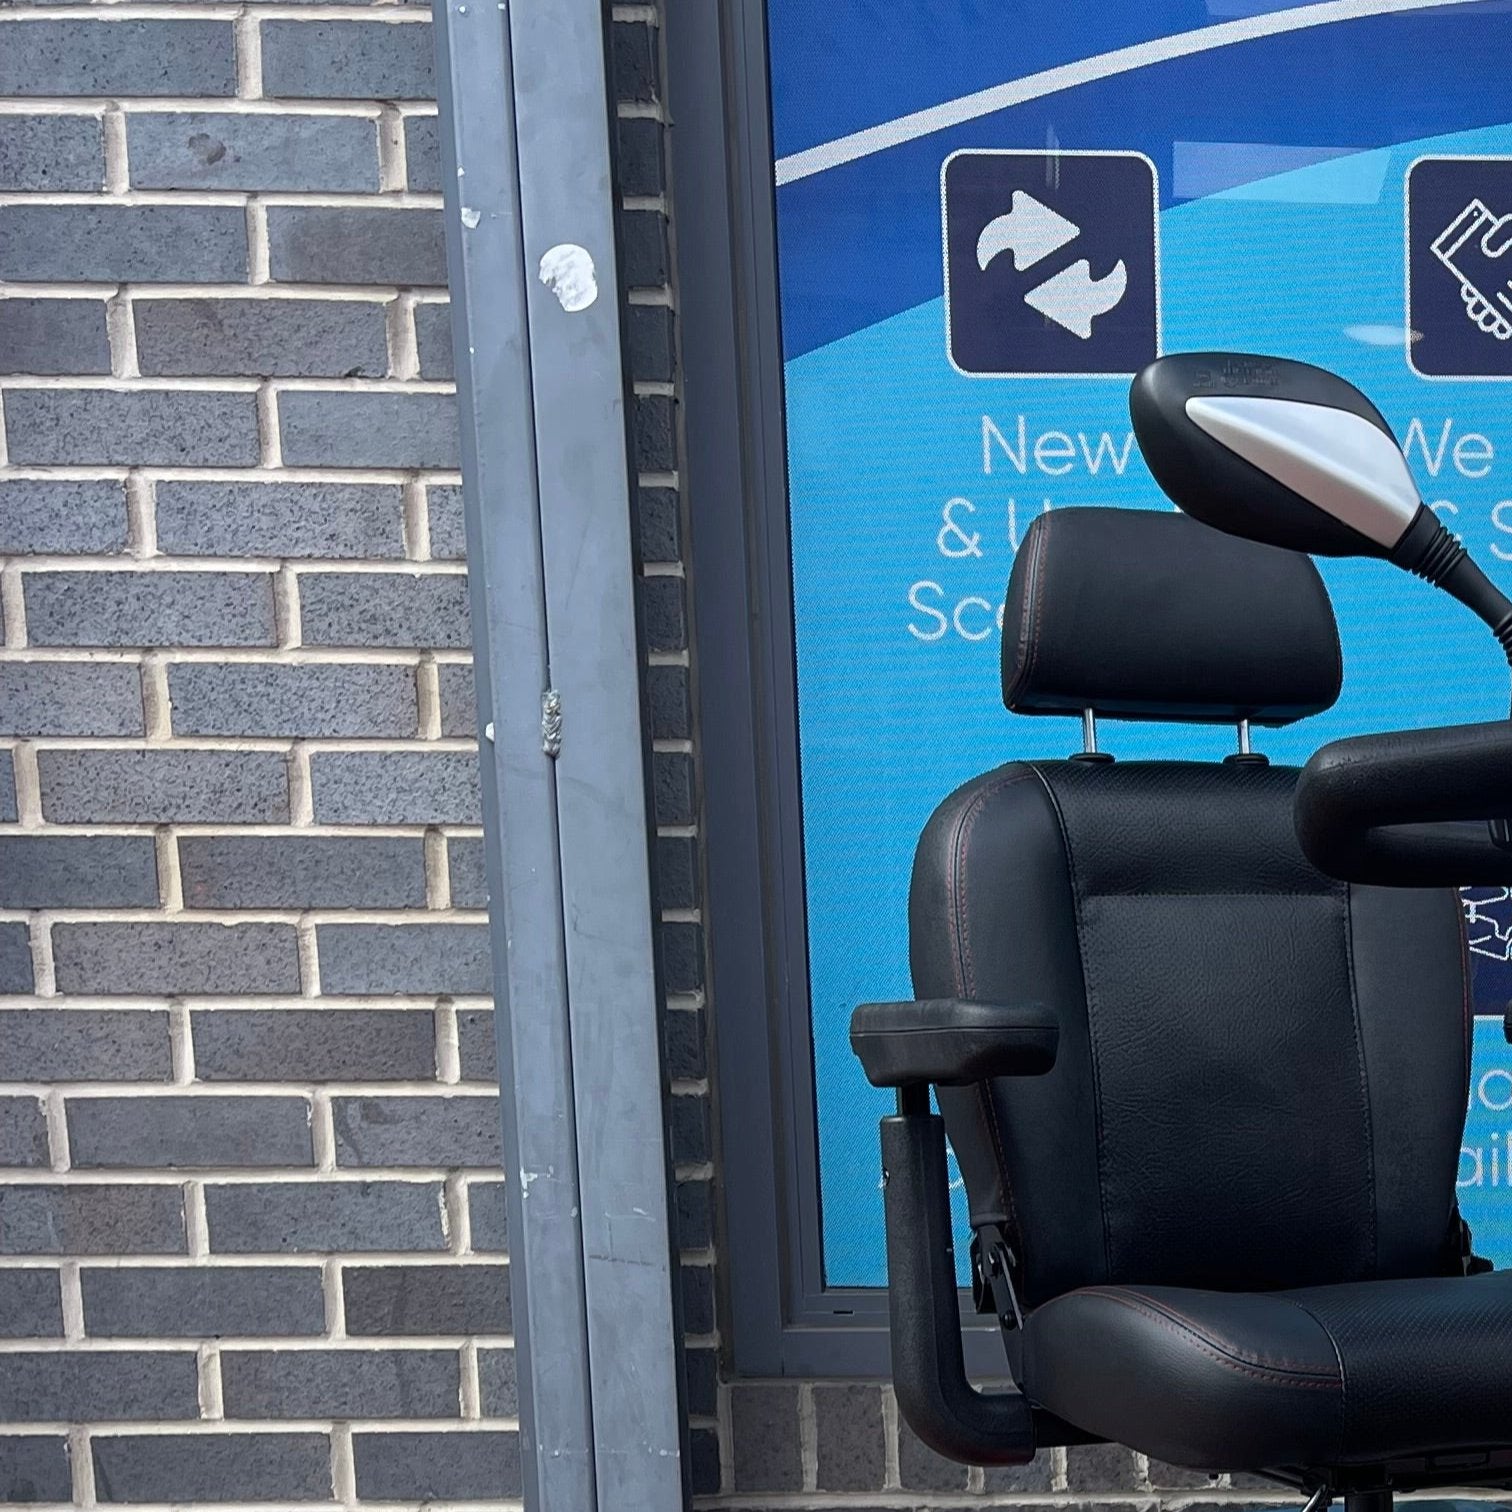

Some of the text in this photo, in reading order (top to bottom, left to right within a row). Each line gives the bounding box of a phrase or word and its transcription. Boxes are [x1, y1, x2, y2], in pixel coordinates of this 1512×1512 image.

[982, 414, 1136, 476] New
[1402, 417, 1495, 479] We
[936, 497, 983, 559] &
